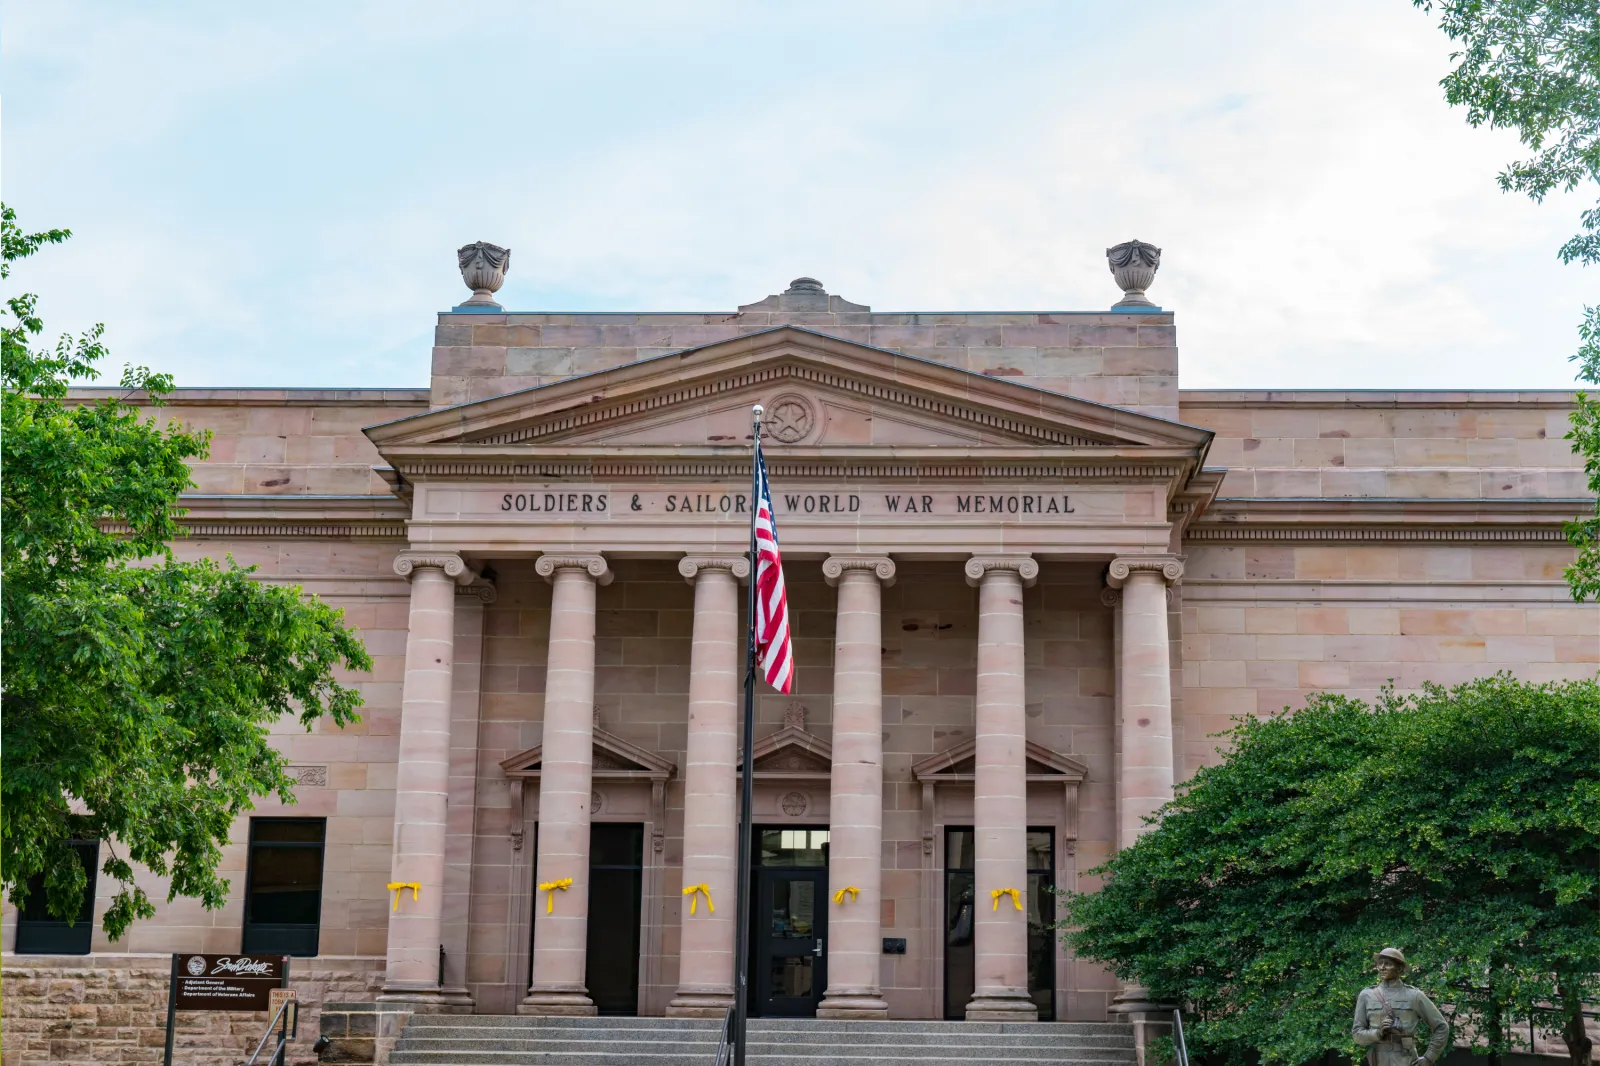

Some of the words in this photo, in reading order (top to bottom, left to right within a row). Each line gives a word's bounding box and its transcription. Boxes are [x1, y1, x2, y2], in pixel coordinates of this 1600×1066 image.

[501, 494, 607, 512] SOLDIERS
[630, 494, 643, 511] &
[665, 495, 753, 513] SAILOR
[784, 495, 861, 513] WORLD
[885, 495, 933, 513] WAR
[956, 495, 1075, 514] MEMORIAL
